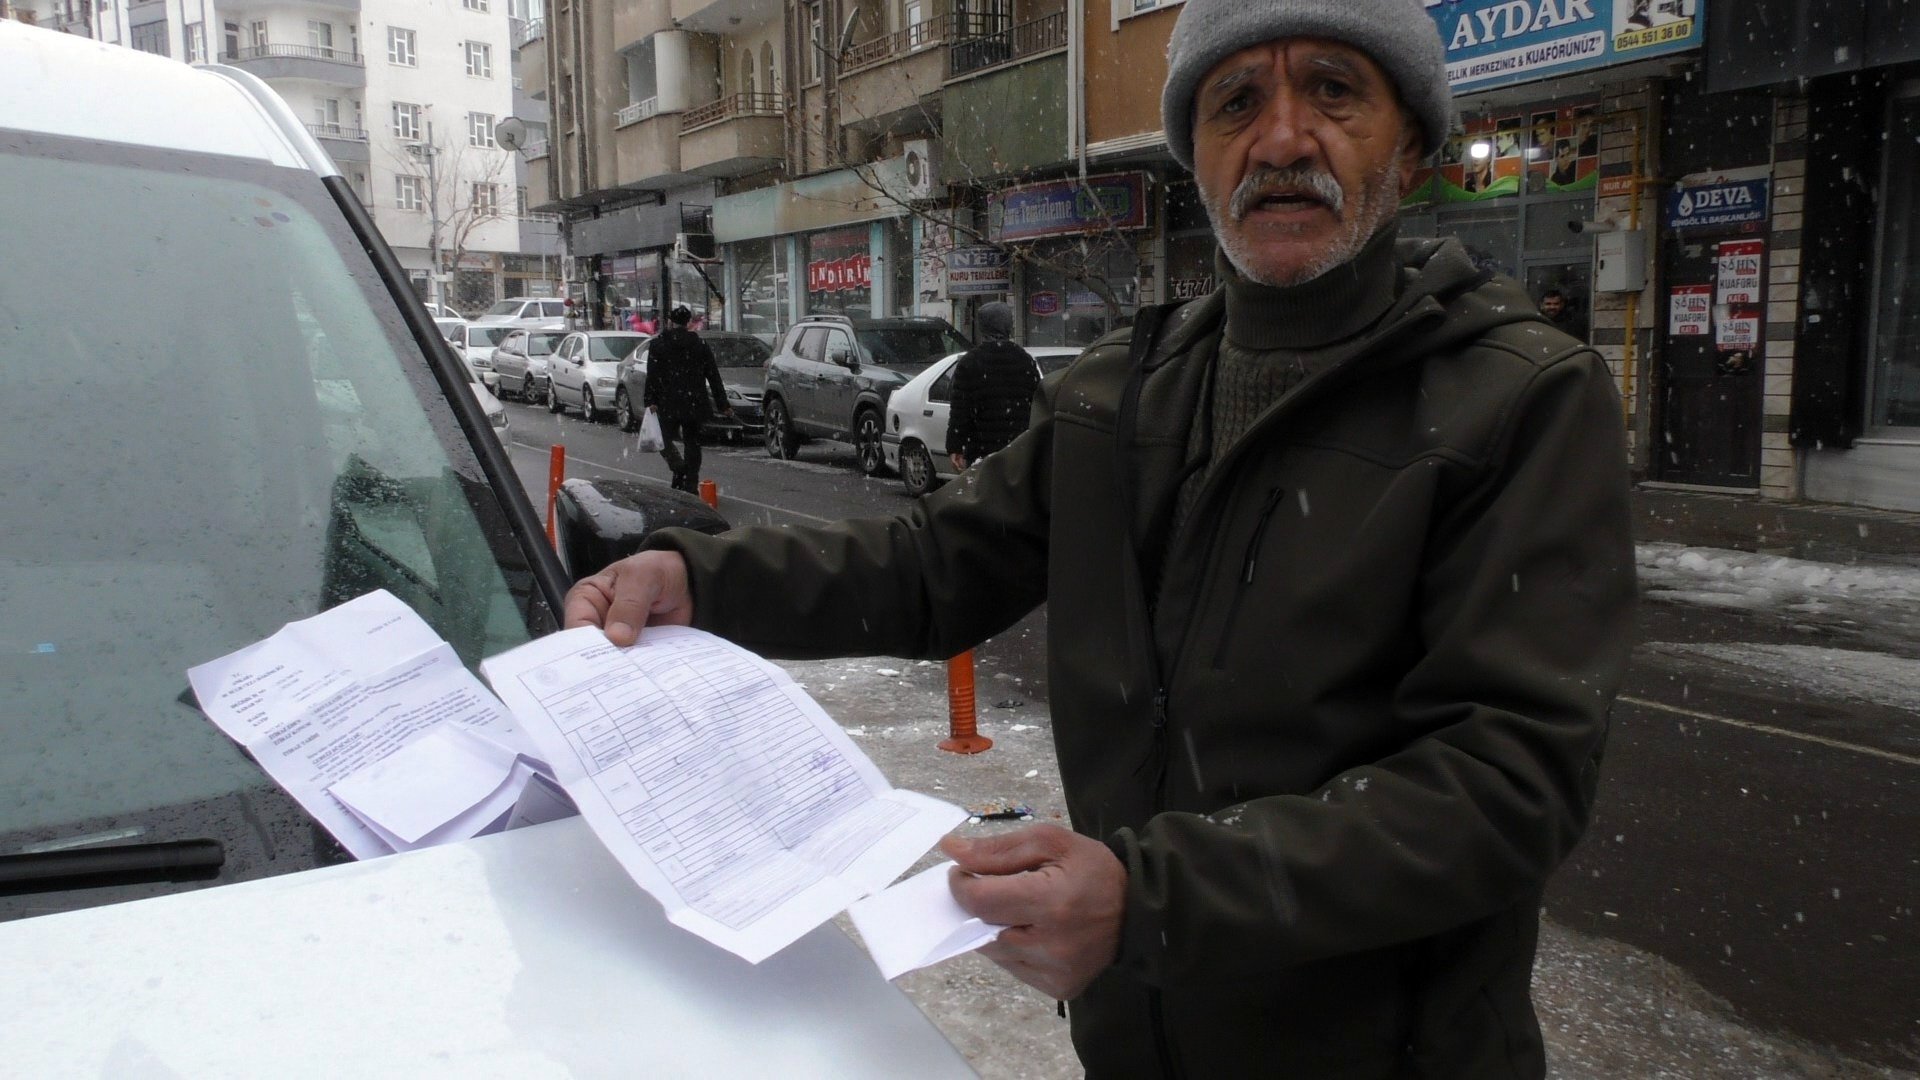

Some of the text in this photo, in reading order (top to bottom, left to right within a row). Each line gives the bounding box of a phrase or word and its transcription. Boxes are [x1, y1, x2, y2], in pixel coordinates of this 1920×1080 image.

[1448, 0, 1594, 50] AYDAR
[1616, 34, 1639, 49] 0544
[1675, 24, 1688, 37] 00
[1447, 67, 1468, 82] ELLİK
[1470, 56, 1516, 77] MERKEZİNİZ
[1517, 57, 1525, 67] &
[1695, 186, 1752, 208] DEVA
[811, 260, 871, 285] İNDİRİM
[950, 271, 969, 281] KURU
